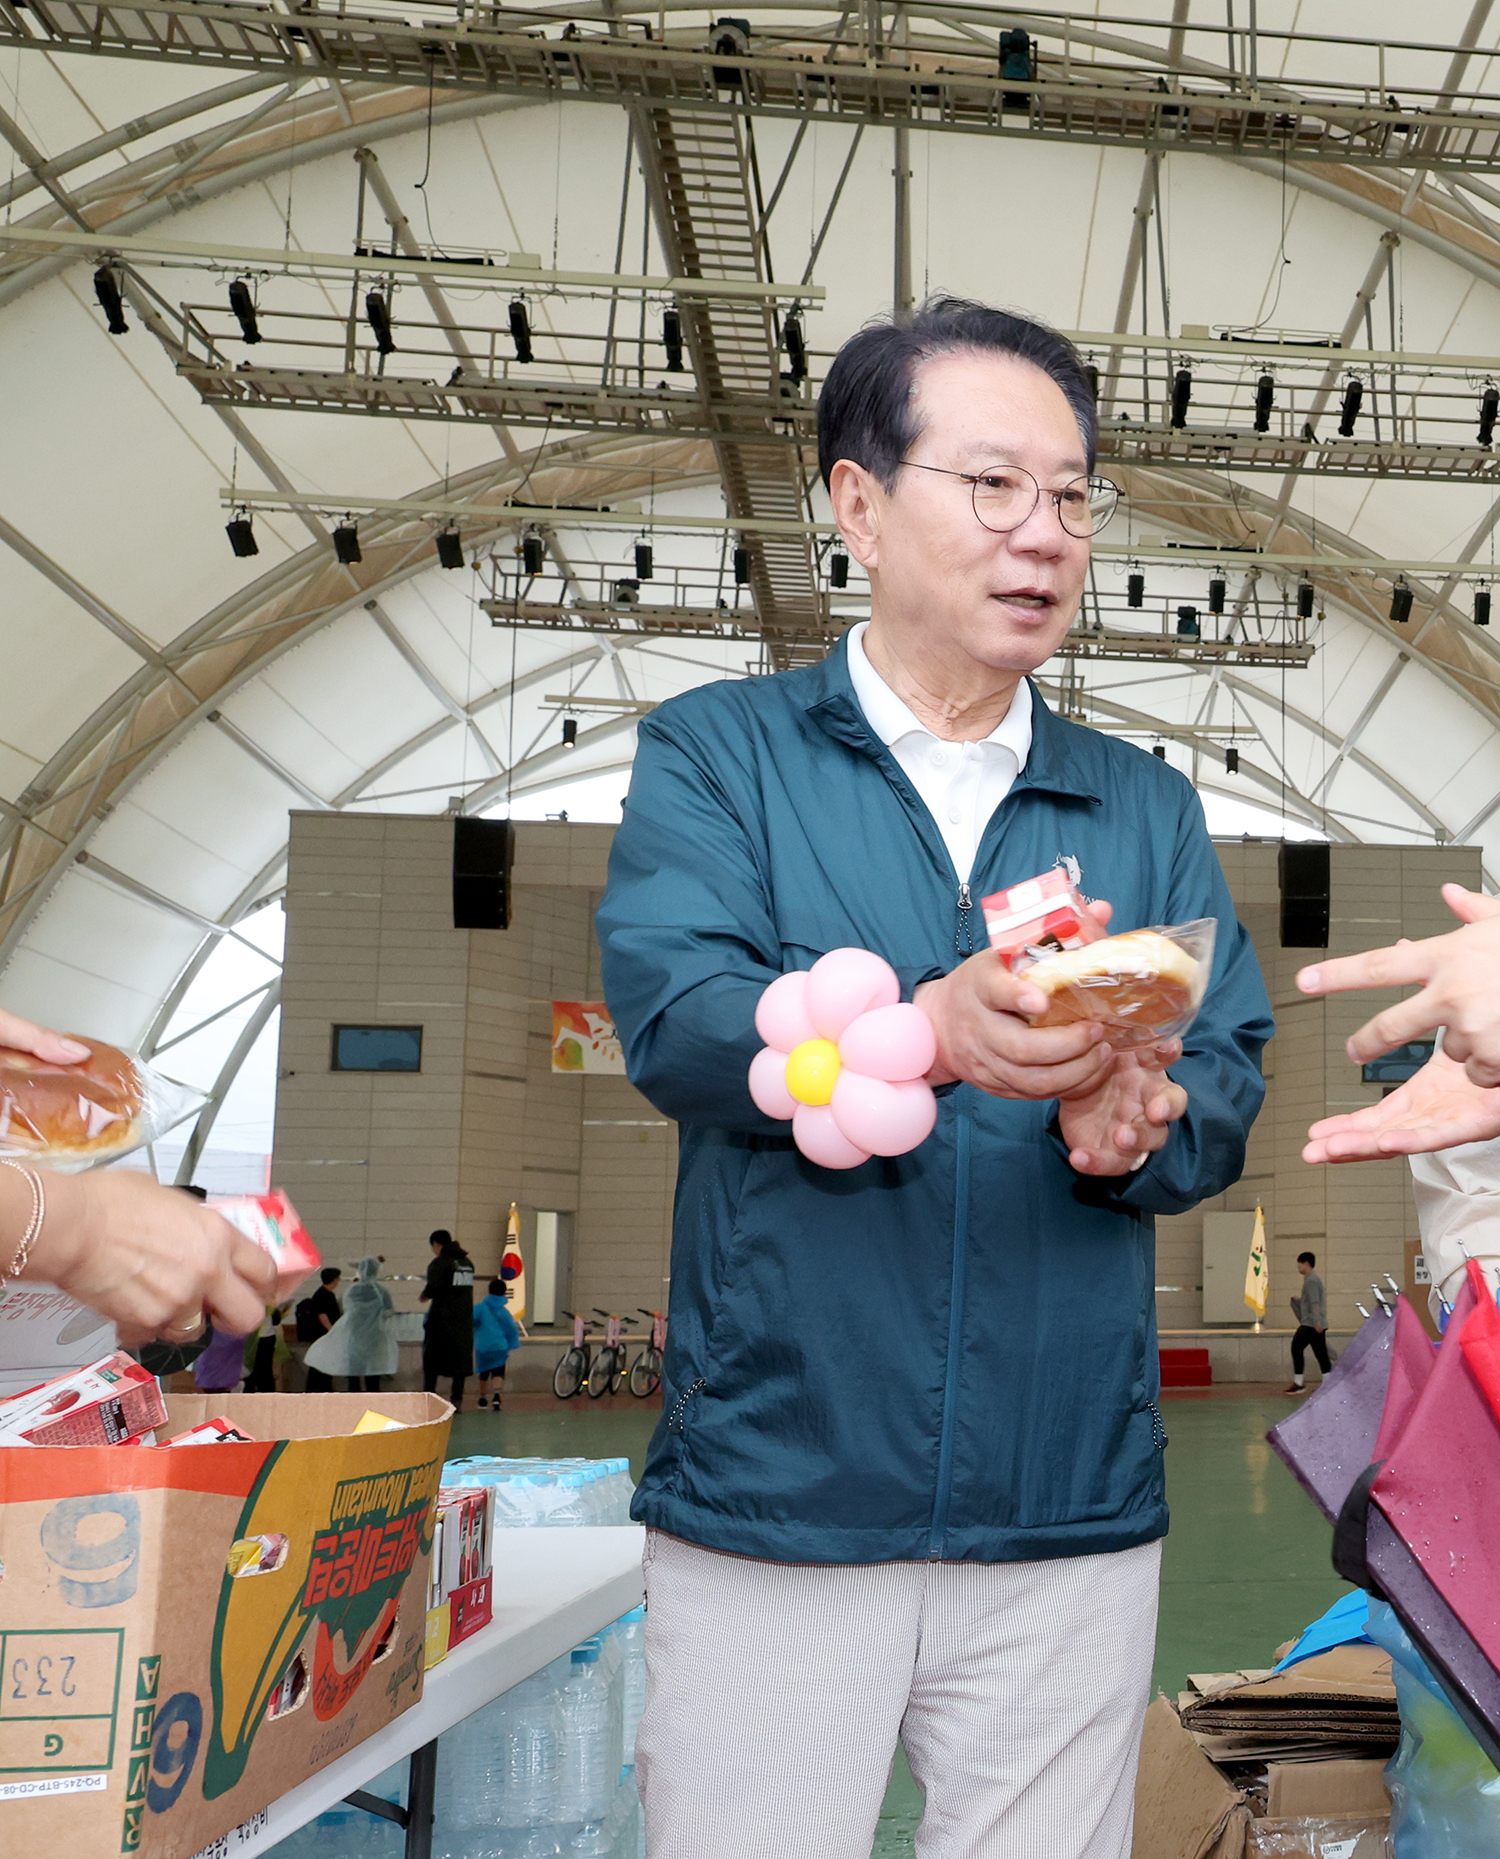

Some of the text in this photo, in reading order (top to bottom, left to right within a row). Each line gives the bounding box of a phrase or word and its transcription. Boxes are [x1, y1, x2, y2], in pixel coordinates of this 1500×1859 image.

[331, 1474, 408, 1530] Mountain
[12, 1655, 76, 1699] 233
[44, 1734, 63, 1757] G
